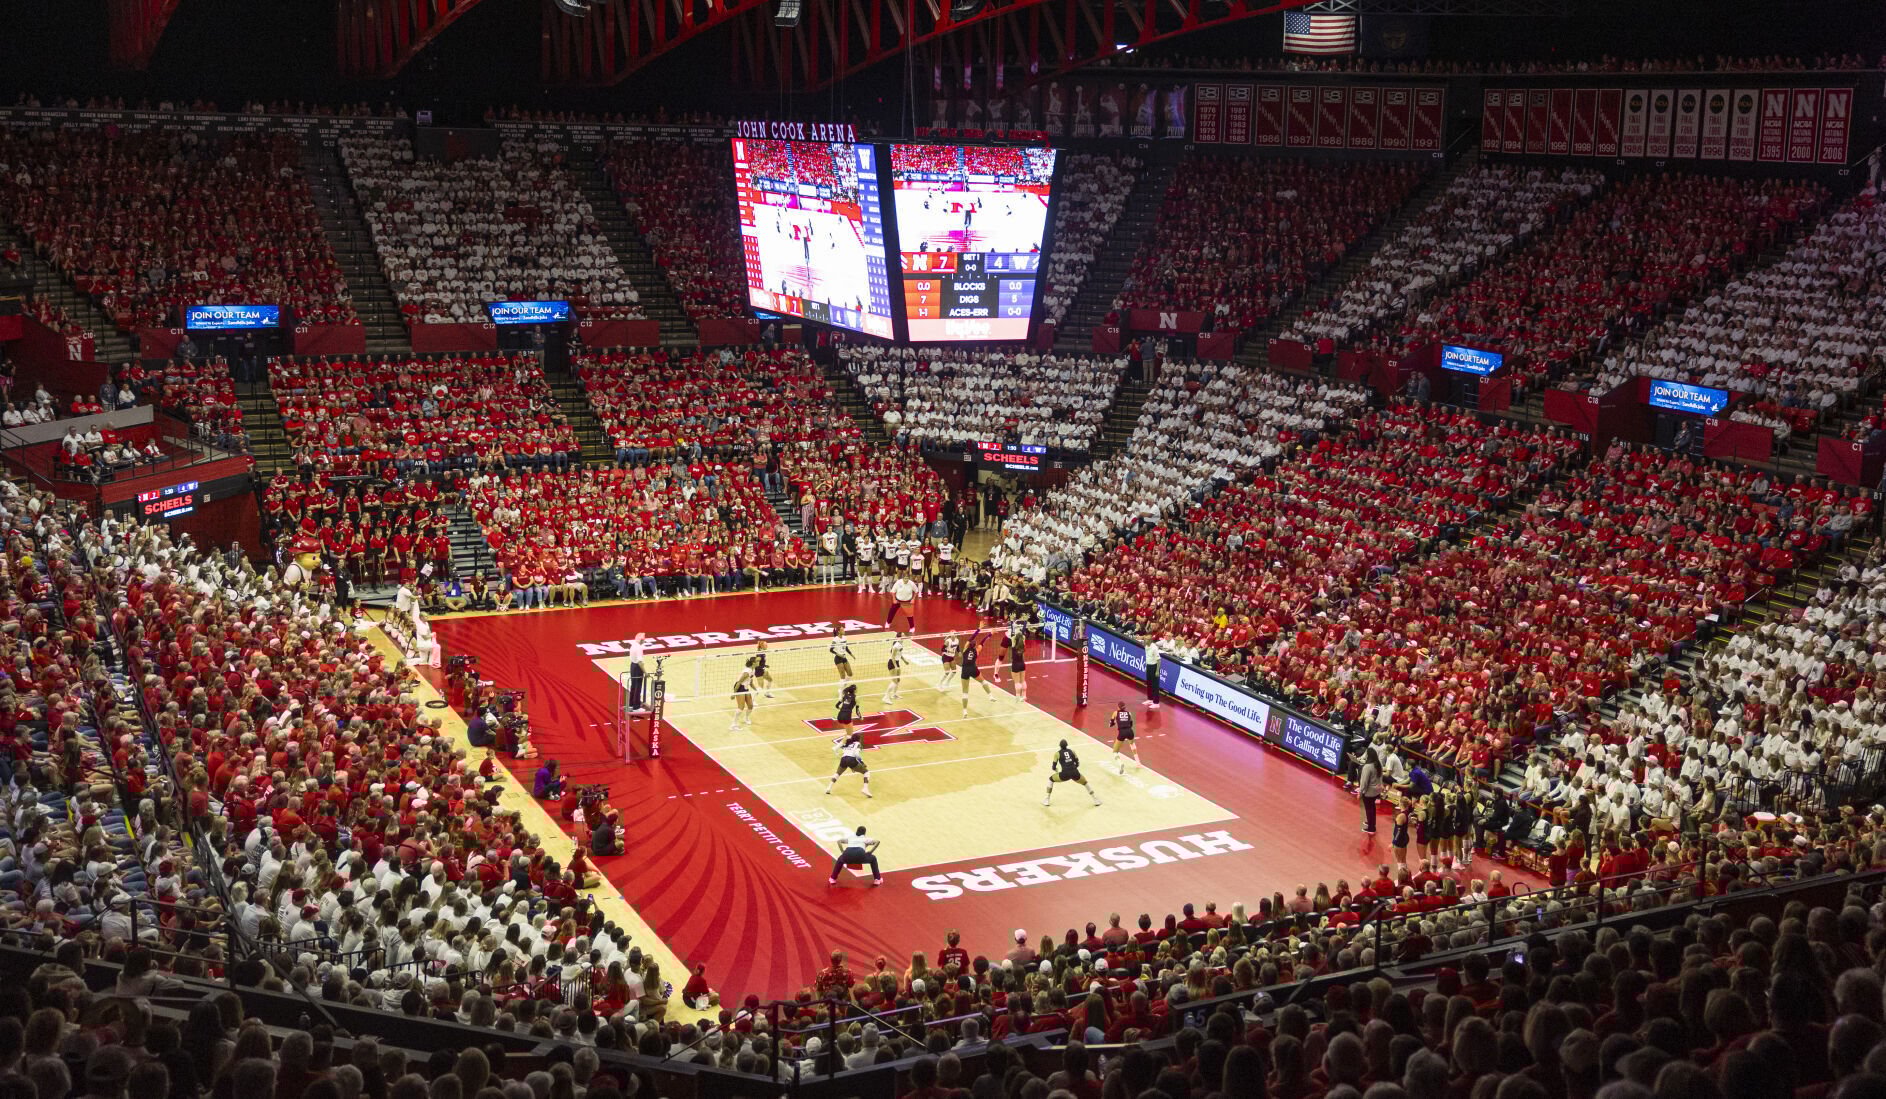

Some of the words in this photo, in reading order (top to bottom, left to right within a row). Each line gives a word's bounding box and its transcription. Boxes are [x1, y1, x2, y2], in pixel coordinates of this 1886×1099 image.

[1765, 93, 1785, 117] N
[1795, 93, 1816, 117] N
[1826, 93, 1847, 118] N
[737, 121, 767, 139] JOHN
[771, 122, 805, 140] COOK
[811, 124, 857, 142] ARENA
[1258, 135, 1280, 143] 1986
[1289, 136, 1311, 144] 1987
[1320, 137, 1342, 145] 1988
[1351, 138, 1373, 146] 1989
[1384, 139, 1406, 147] 1990
[1415, 139, 1439, 147] 1991
[1484, 140, 1500, 148] 1992
[1505, 141, 1521, 149] 1994
[1551, 142, 1567, 150] 1996
[1574, 143, 1592, 151] 1998
[1599, 144, 1616, 152] 1999
[1762, 145, 1781, 158] 1995
[1791, 146, 1810, 159] 2000
[1823, 147, 1842, 160] 2006
[912, 254, 928, 271] N
[940, 256, 948, 269] 7
[994, 256, 1003, 269] 4
[1012, 256, 1030, 269] W
[917, 282, 931, 291] 0.0
[953, 282, 986, 291] BLOCKS
[1008, 282, 1022, 291] 0.0
[920, 296, 927, 304] 7
[959, 295, 979, 304] DIGS
[191, 312, 212, 321] JOIN
[491, 307, 510, 316] JOIN
[511, 307, 529, 315] OUR
[918, 308, 928, 317] 1-1
[949, 308, 989, 317] ACES-ERR
[1007, 307, 1022, 316] 0-0
[1159, 312, 1177, 329] N
[69, 344, 82, 361] N
[1445, 351, 1459, 360] JOIN
[1459, 353, 1473, 362] OUR
[1473, 355, 1489, 365] TEAM
[1587, 396, 1599, 404] C18
[1654, 386, 1671, 396] JOIN
[1672, 389, 1689, 399] OUR
[1690, 392, 1711, 403] TEAM
[1706, 418, 1719, 426] C18
[983, 452, 1039, 465] SCHEELS
[144, 495, 193, 515] SCHEELS
[1047, 609, 1062, 621] Good
[576, 619, 882, 655] NEBRASKA
[1109, 643, 1147, 673] Nebrask
[1180, 679, 1205, 699] Serving
[1205, 691, 1214, 704] up
[1215, 693, 1229, 708] The
[1228, 701, 1247, 718] Good
[1246, 709, 1262, 724] Life.
[1119, 711, 1129, 719] 22
[652, 700, 661, 756] NEBRASKA
[1269, 715, 1282, 736] N
[1288, 717, 1302, 734] The
[1304, 722, 1325, 743] Good
[1325, 732, 1341, 751] Life
[1285, 735, 1293, 747] Is
[1293, 739, 1320, 760] Calling
[727, 802, 757, 822] TERRY
[749, 822, 783, 844] PETTIT
[776, 845, 811, 868] COURT
[911, 830, 1255, 900] HUSKERS
